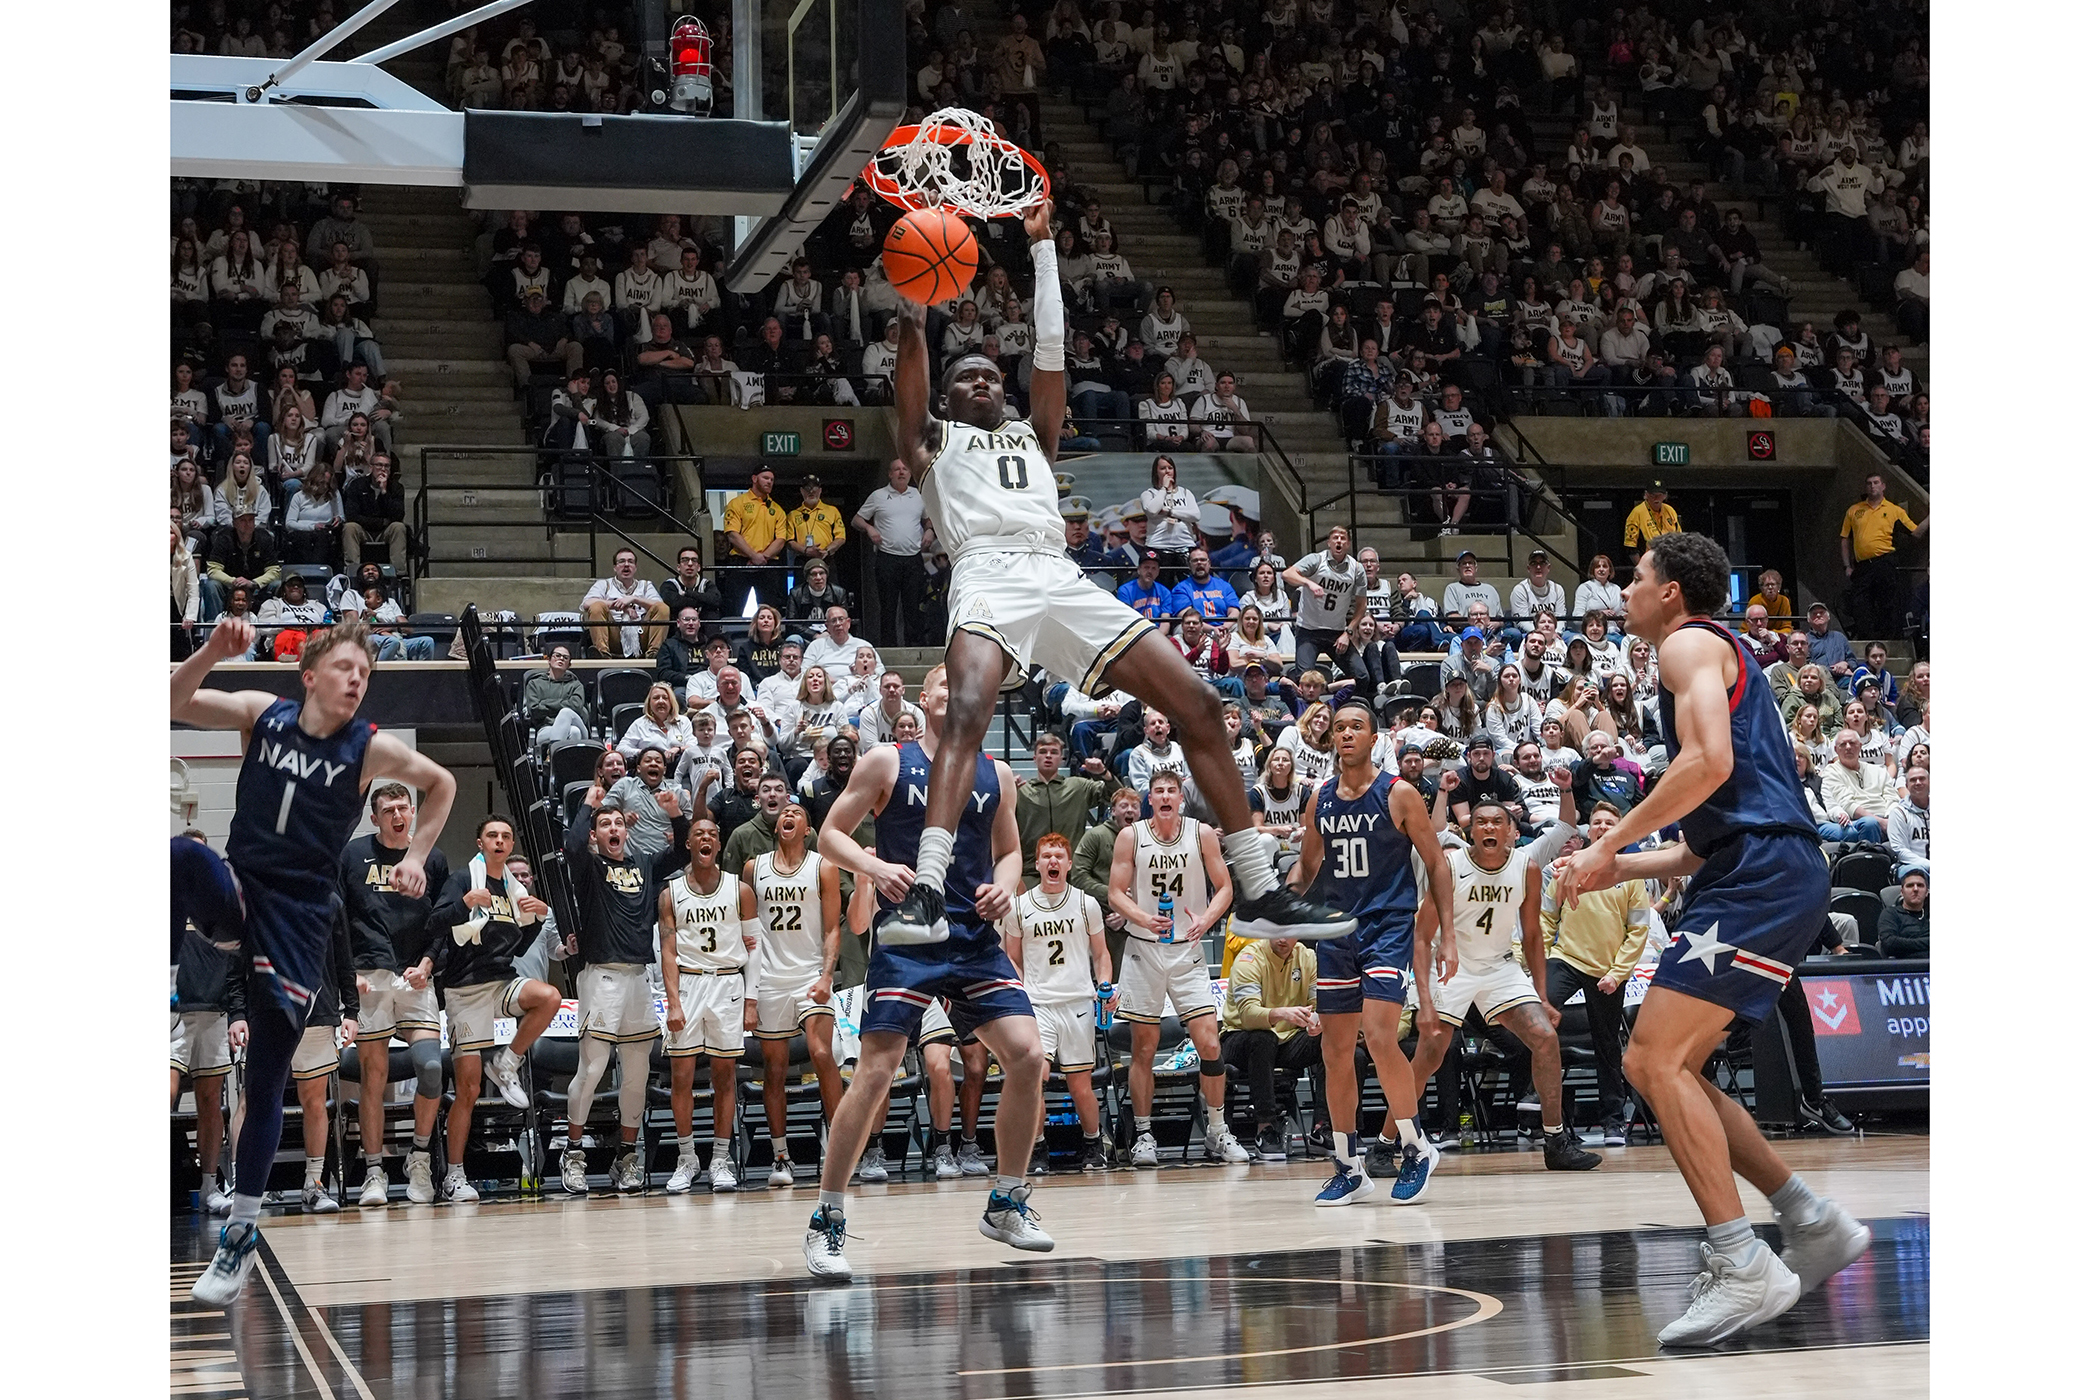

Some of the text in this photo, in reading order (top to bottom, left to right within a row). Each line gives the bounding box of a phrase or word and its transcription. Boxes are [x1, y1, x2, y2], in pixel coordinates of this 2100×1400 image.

[1013, 51, 1024, 69] 3
[1153, 65, 1174, 74] ARMY
[1596, 115, 1615, 123] ARMY
[1220, 196, 1240, 205] ARMY
[1228, 207, 1236, 217] 6
[1604, 212, 1624, 222] ARMY
[851, 226, 870, 234] ARMY
[1243, 234, 1265, 243] ARMY
[1096, 261, 1121, 271] ARMY
[1274, 264, 1297, 272] ARMY
[519, 284, 546, 295] AY
[678, 287, 704, 298] ARMY
[1528, 309, 1546, 318] ARM
[1571, 304, 1594, 314] ARMY
[1160, 330, 1180, 341] ARMY
[880, 357, 897, 367] AR
[1886, 382, 1910, 391] ARMY
[225, 402, 253, 415] ARMY
[1207, 412, 1235, 422] ARMY
[1394, 414, 1420, 425] ARMY
[1452, 419, 1464, 427] 6
[1168, 425, 1177, 436] 6
[766, 436, 795, 453] EXIT
[966, 433, 1040, 453] ARMY
[1660, 446, 1685, 462] EXIT
[997, 455, 1030, 490] 0
[1319, 577, 1351, 592] ARMY
[1203, 601, 1216, 617] 11
[1324, 594, 1337, 611] 6
[1531, 602, 1557, 612] ARMY
[1520, 687, 1549, 701] ARMY
[1508, 714, 1529, 734] ARMY
[257, 737, 347, 788] NAVY
[692, 756, 708, 765] WEST
[1152, 761, 1183, 772] ARMY
[1297, 749, 1330, 769] ARMY
[907, 783, 991, 813] NY
[275, 779, 297, 835] 1
[1264, 809, 1300, 825] ARMY
[1320, 813, 1380, 834] NAVY
[1149, 853, 1188, 869] ARMY
[1331, 837, 1369, 878] 30
[365, 863, 394, 885] AR
[605, 866, 645, 885] ARMY
[1151, 873, 1183, 897] 54
[764, 886, 808, 902] ARMY
[1468, 885, 1514, 903] ARMY
[686, 905, 727, 924] ARMY
[769, 905, 802, 931] 22
[1476, 907, 1494, 935] 4
[1033, 918, 1075, 938] ARMY
[699, 927, 717, 953] 3
[1048, 940, 1064, 966] 2
[845, 987, 854, 1018] OWERADE
